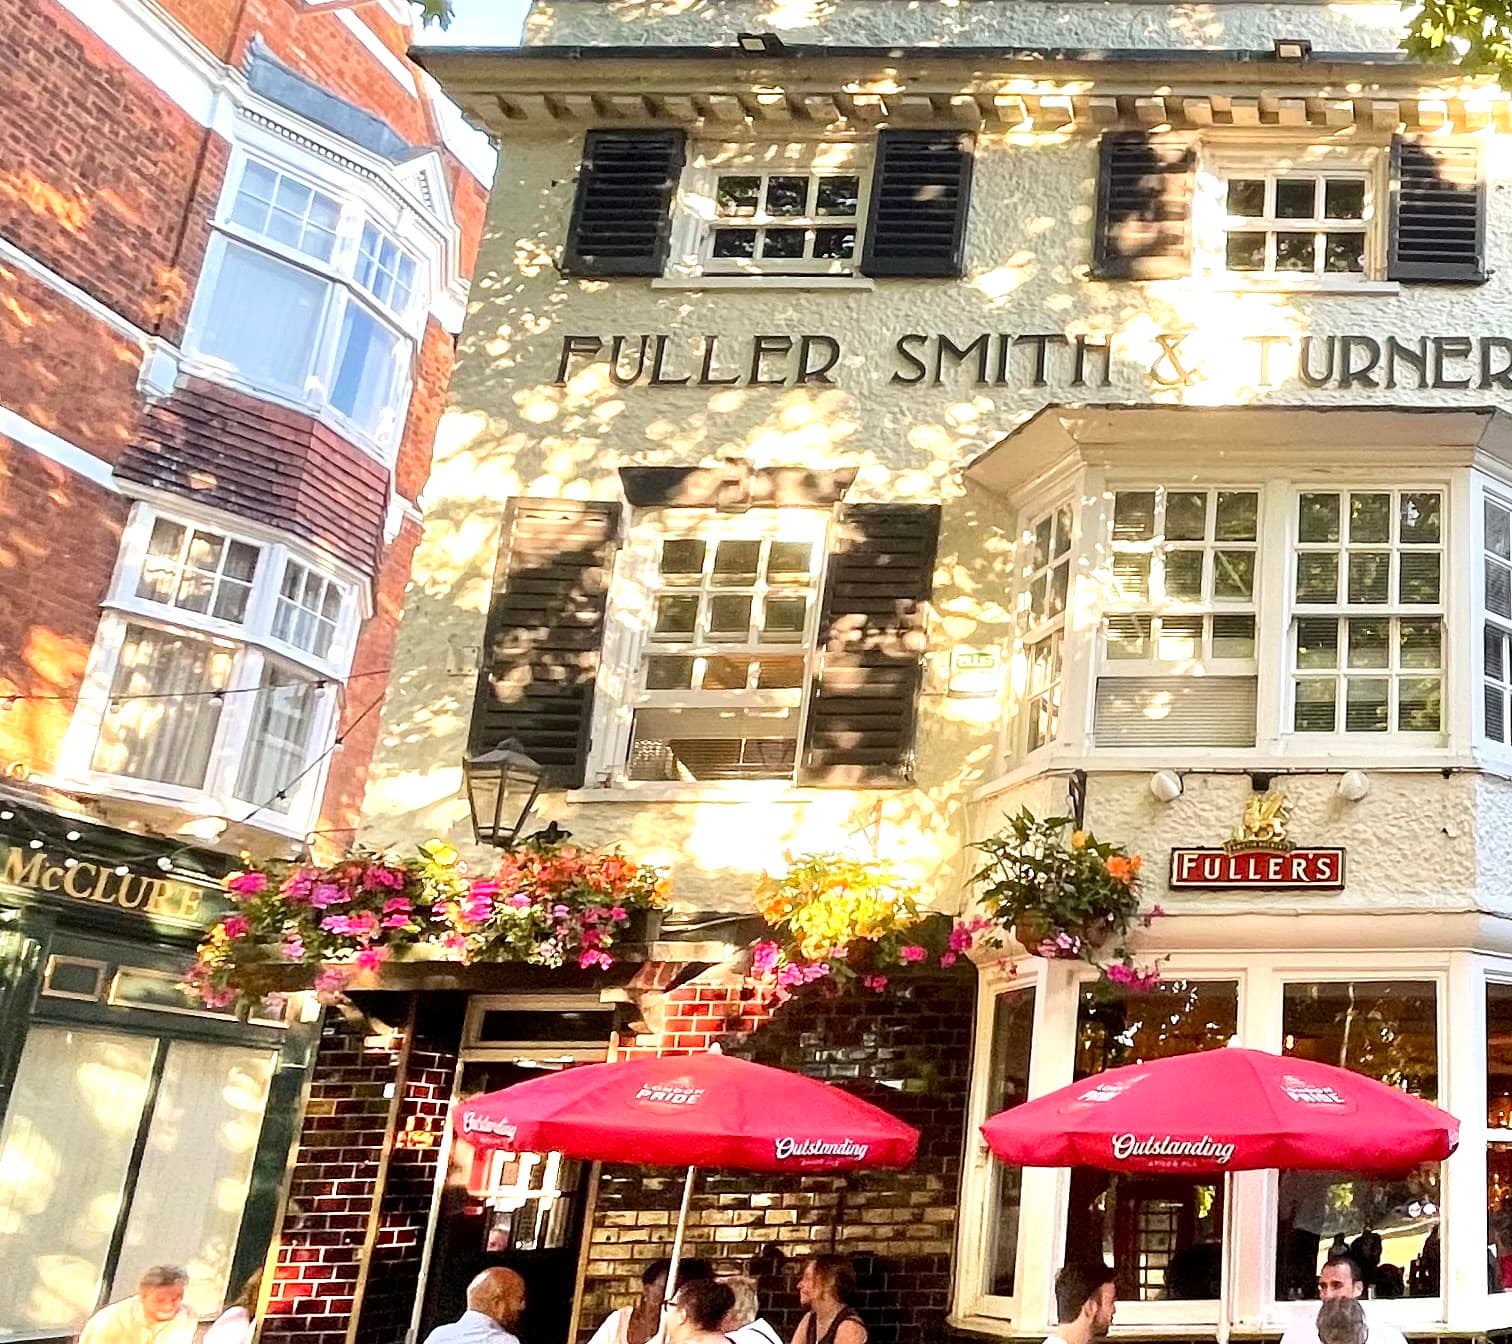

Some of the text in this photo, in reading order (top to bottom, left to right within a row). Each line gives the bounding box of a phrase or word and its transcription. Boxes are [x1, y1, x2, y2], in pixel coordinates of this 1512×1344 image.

[554, 333, 842, 389] FULLER
[890, 332, 1113, 389] SMITH
[1145, 333, 1198, 388] &
[1181, 853, 1332, 882] FULLER'S
[4, 846, 203, 921] McCLURE
[635, 1089, 701, 1105] PRIDE
[775, 1136, 869, 1161] Outstanding
[1111, 1133, 1236, 1164] Outstanding
